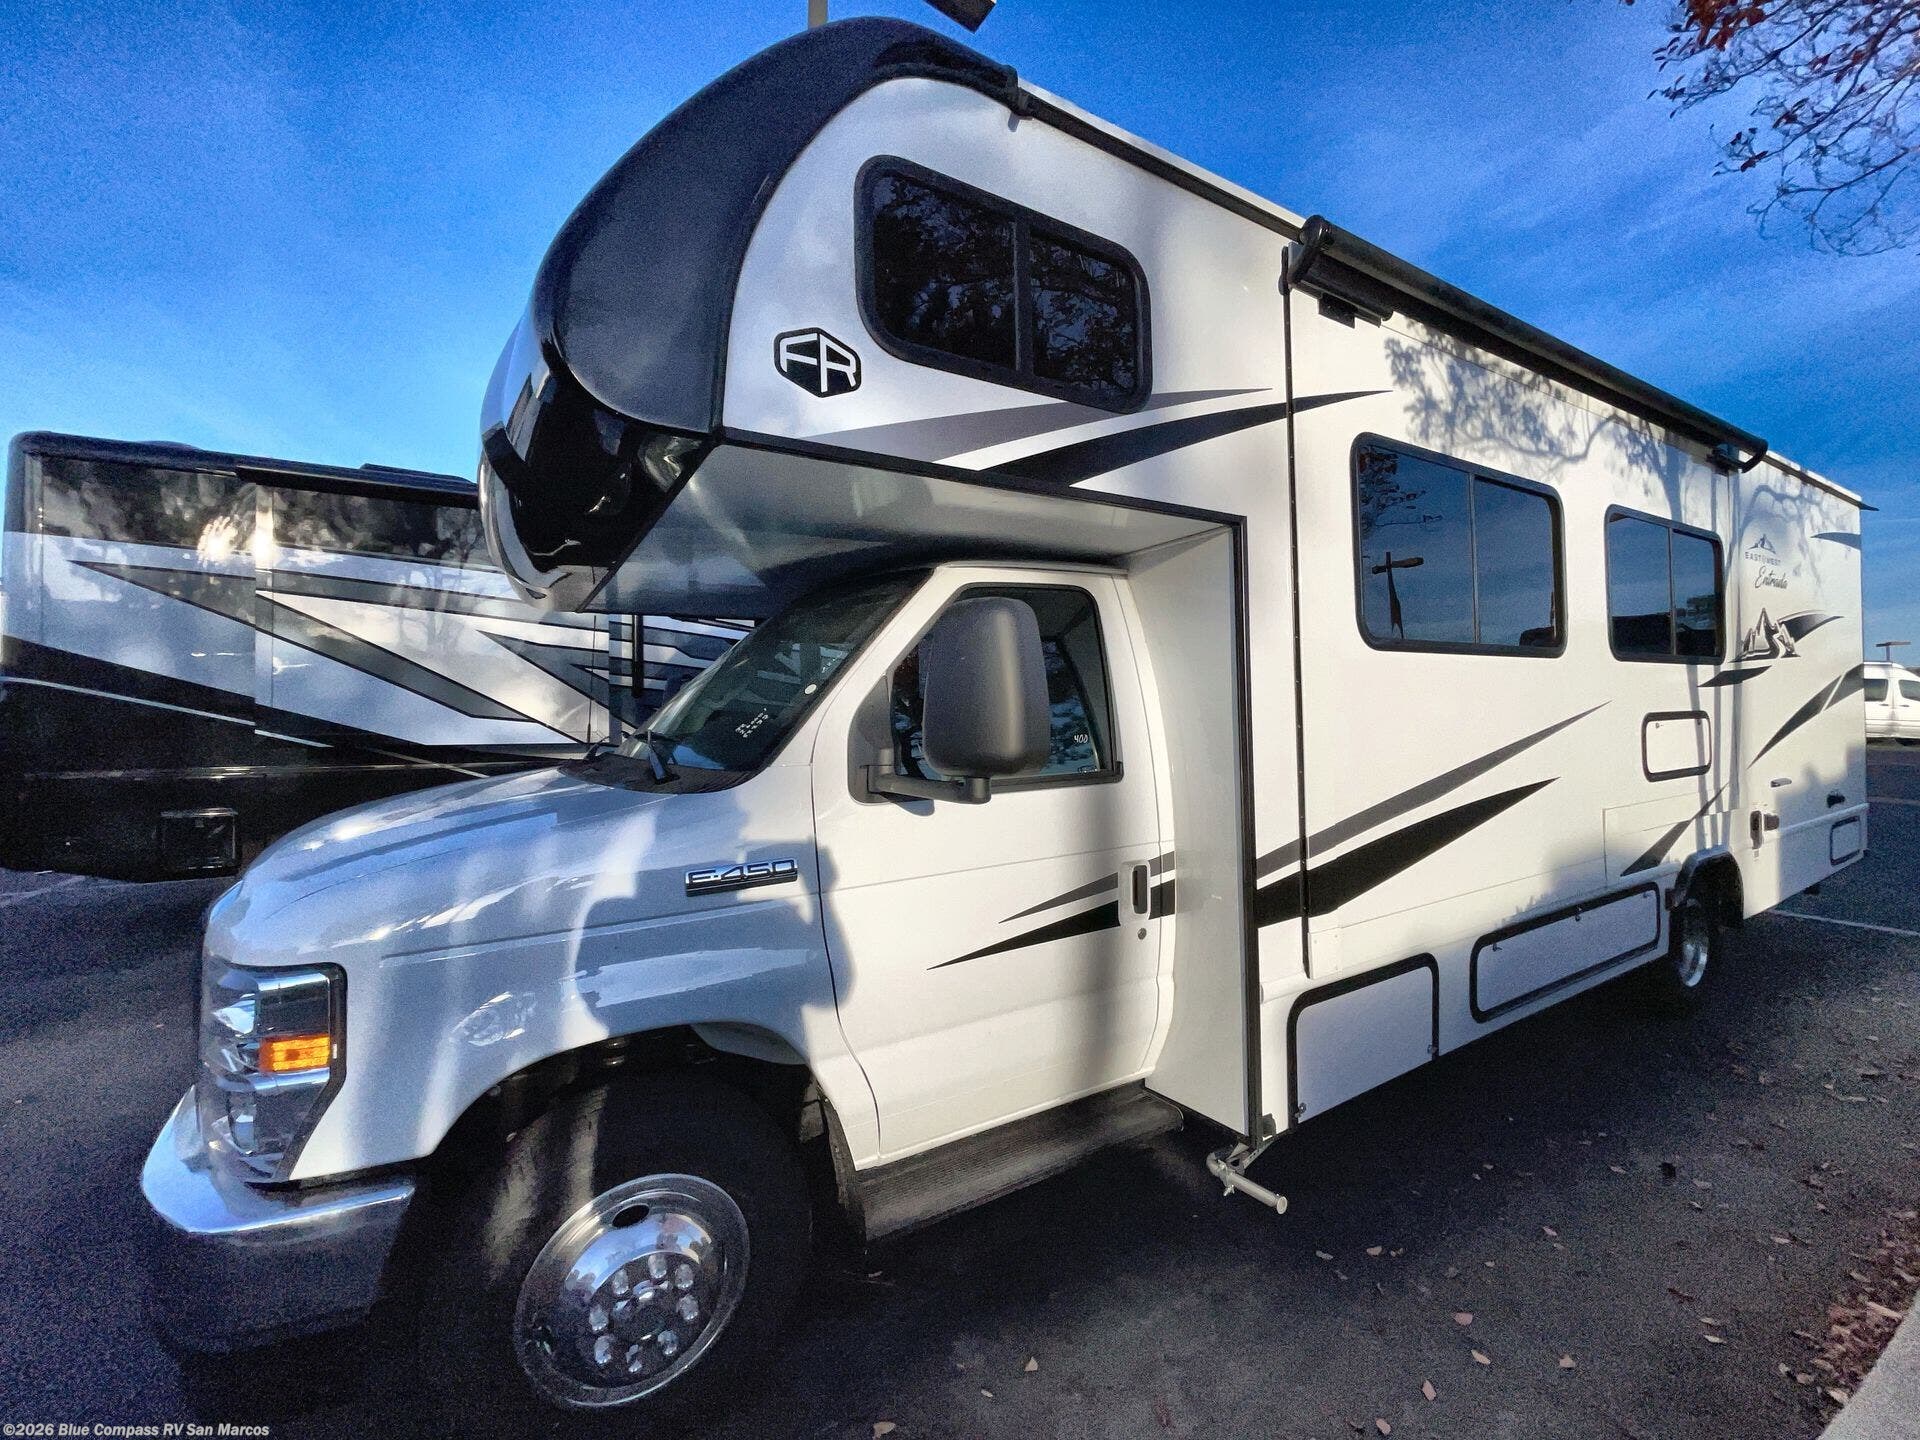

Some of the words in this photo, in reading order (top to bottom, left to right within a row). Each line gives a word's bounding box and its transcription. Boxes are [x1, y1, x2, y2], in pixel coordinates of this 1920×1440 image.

[778, 331, 858, 395] FR
[1754, 565, 1788, 589] Entrada
[685, 858, 798, 886] E-450
